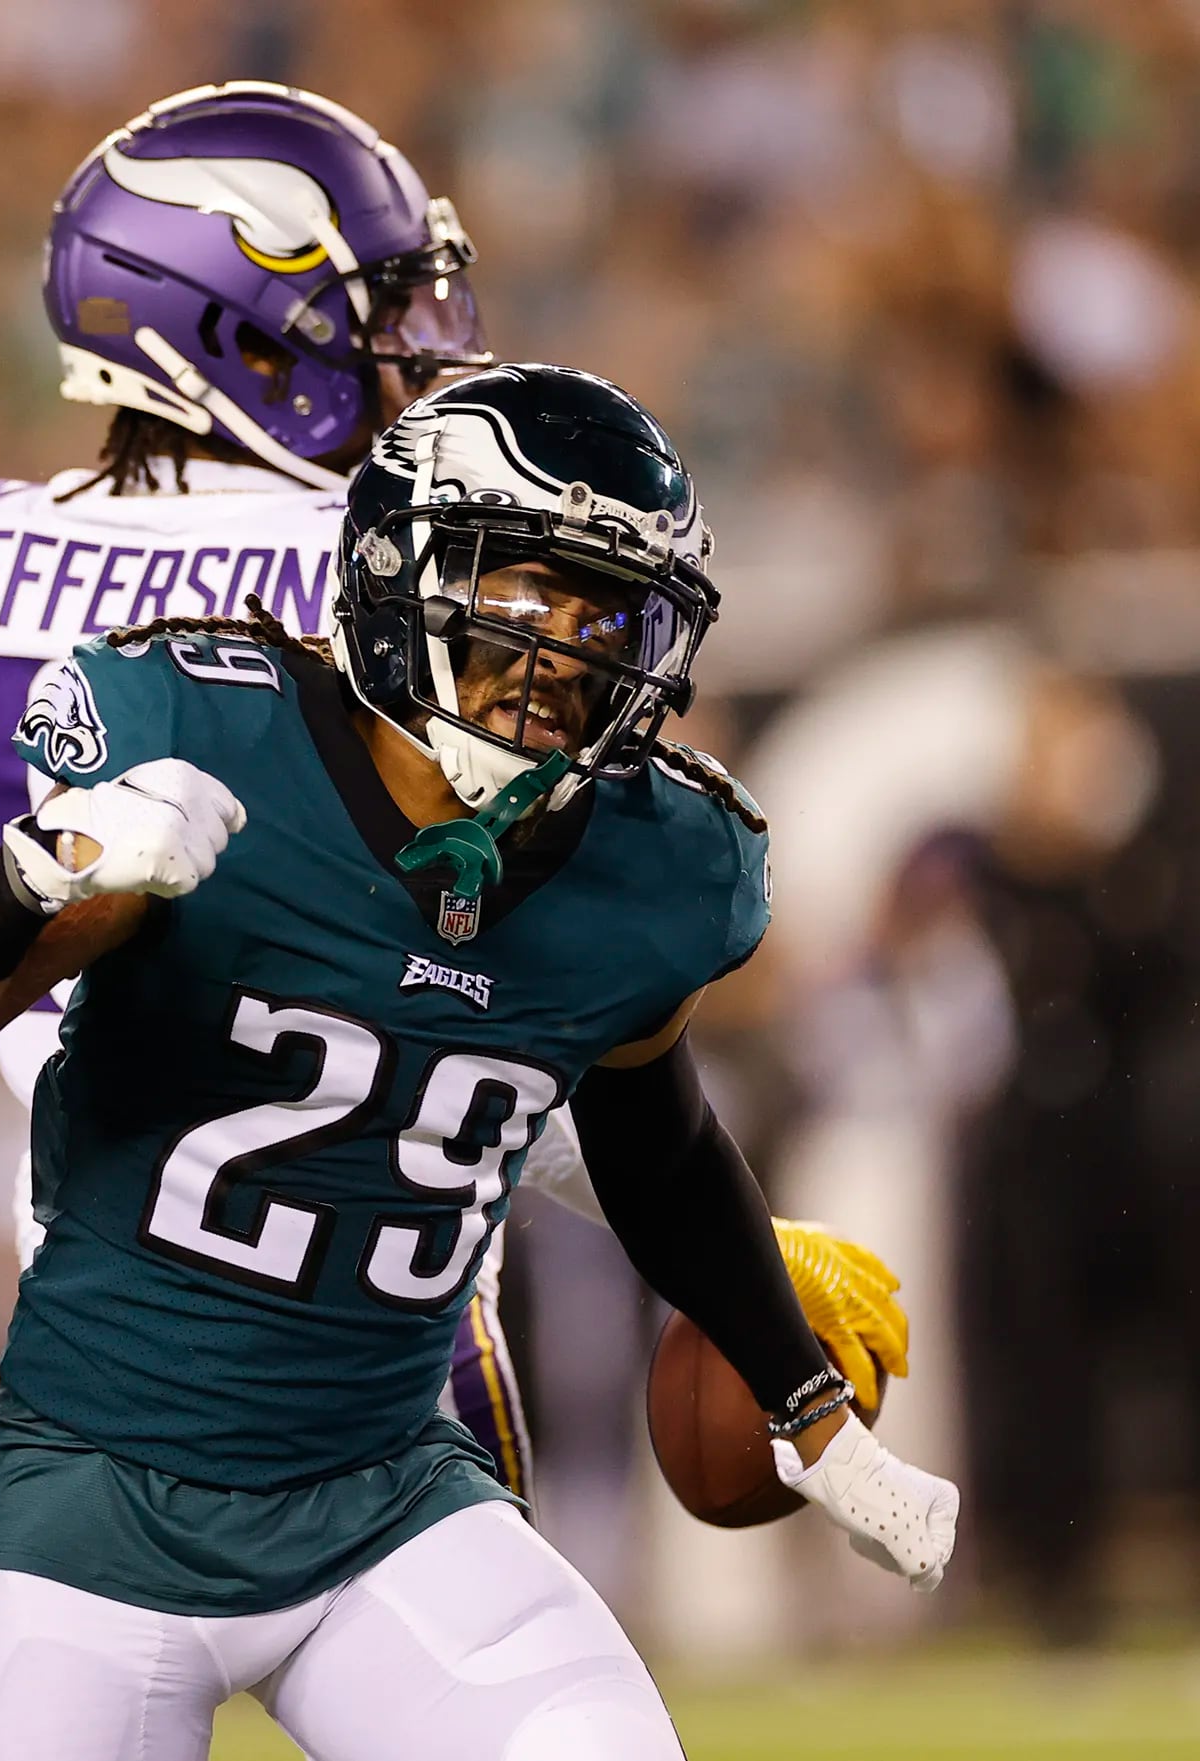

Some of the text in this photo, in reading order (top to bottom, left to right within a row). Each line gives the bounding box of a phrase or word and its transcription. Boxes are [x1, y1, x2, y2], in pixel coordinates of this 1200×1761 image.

[444, 911, 472, 935] NFL
[400, 953, 495, 1010] EAGLES
[144, 990, 562, 1304] 29
